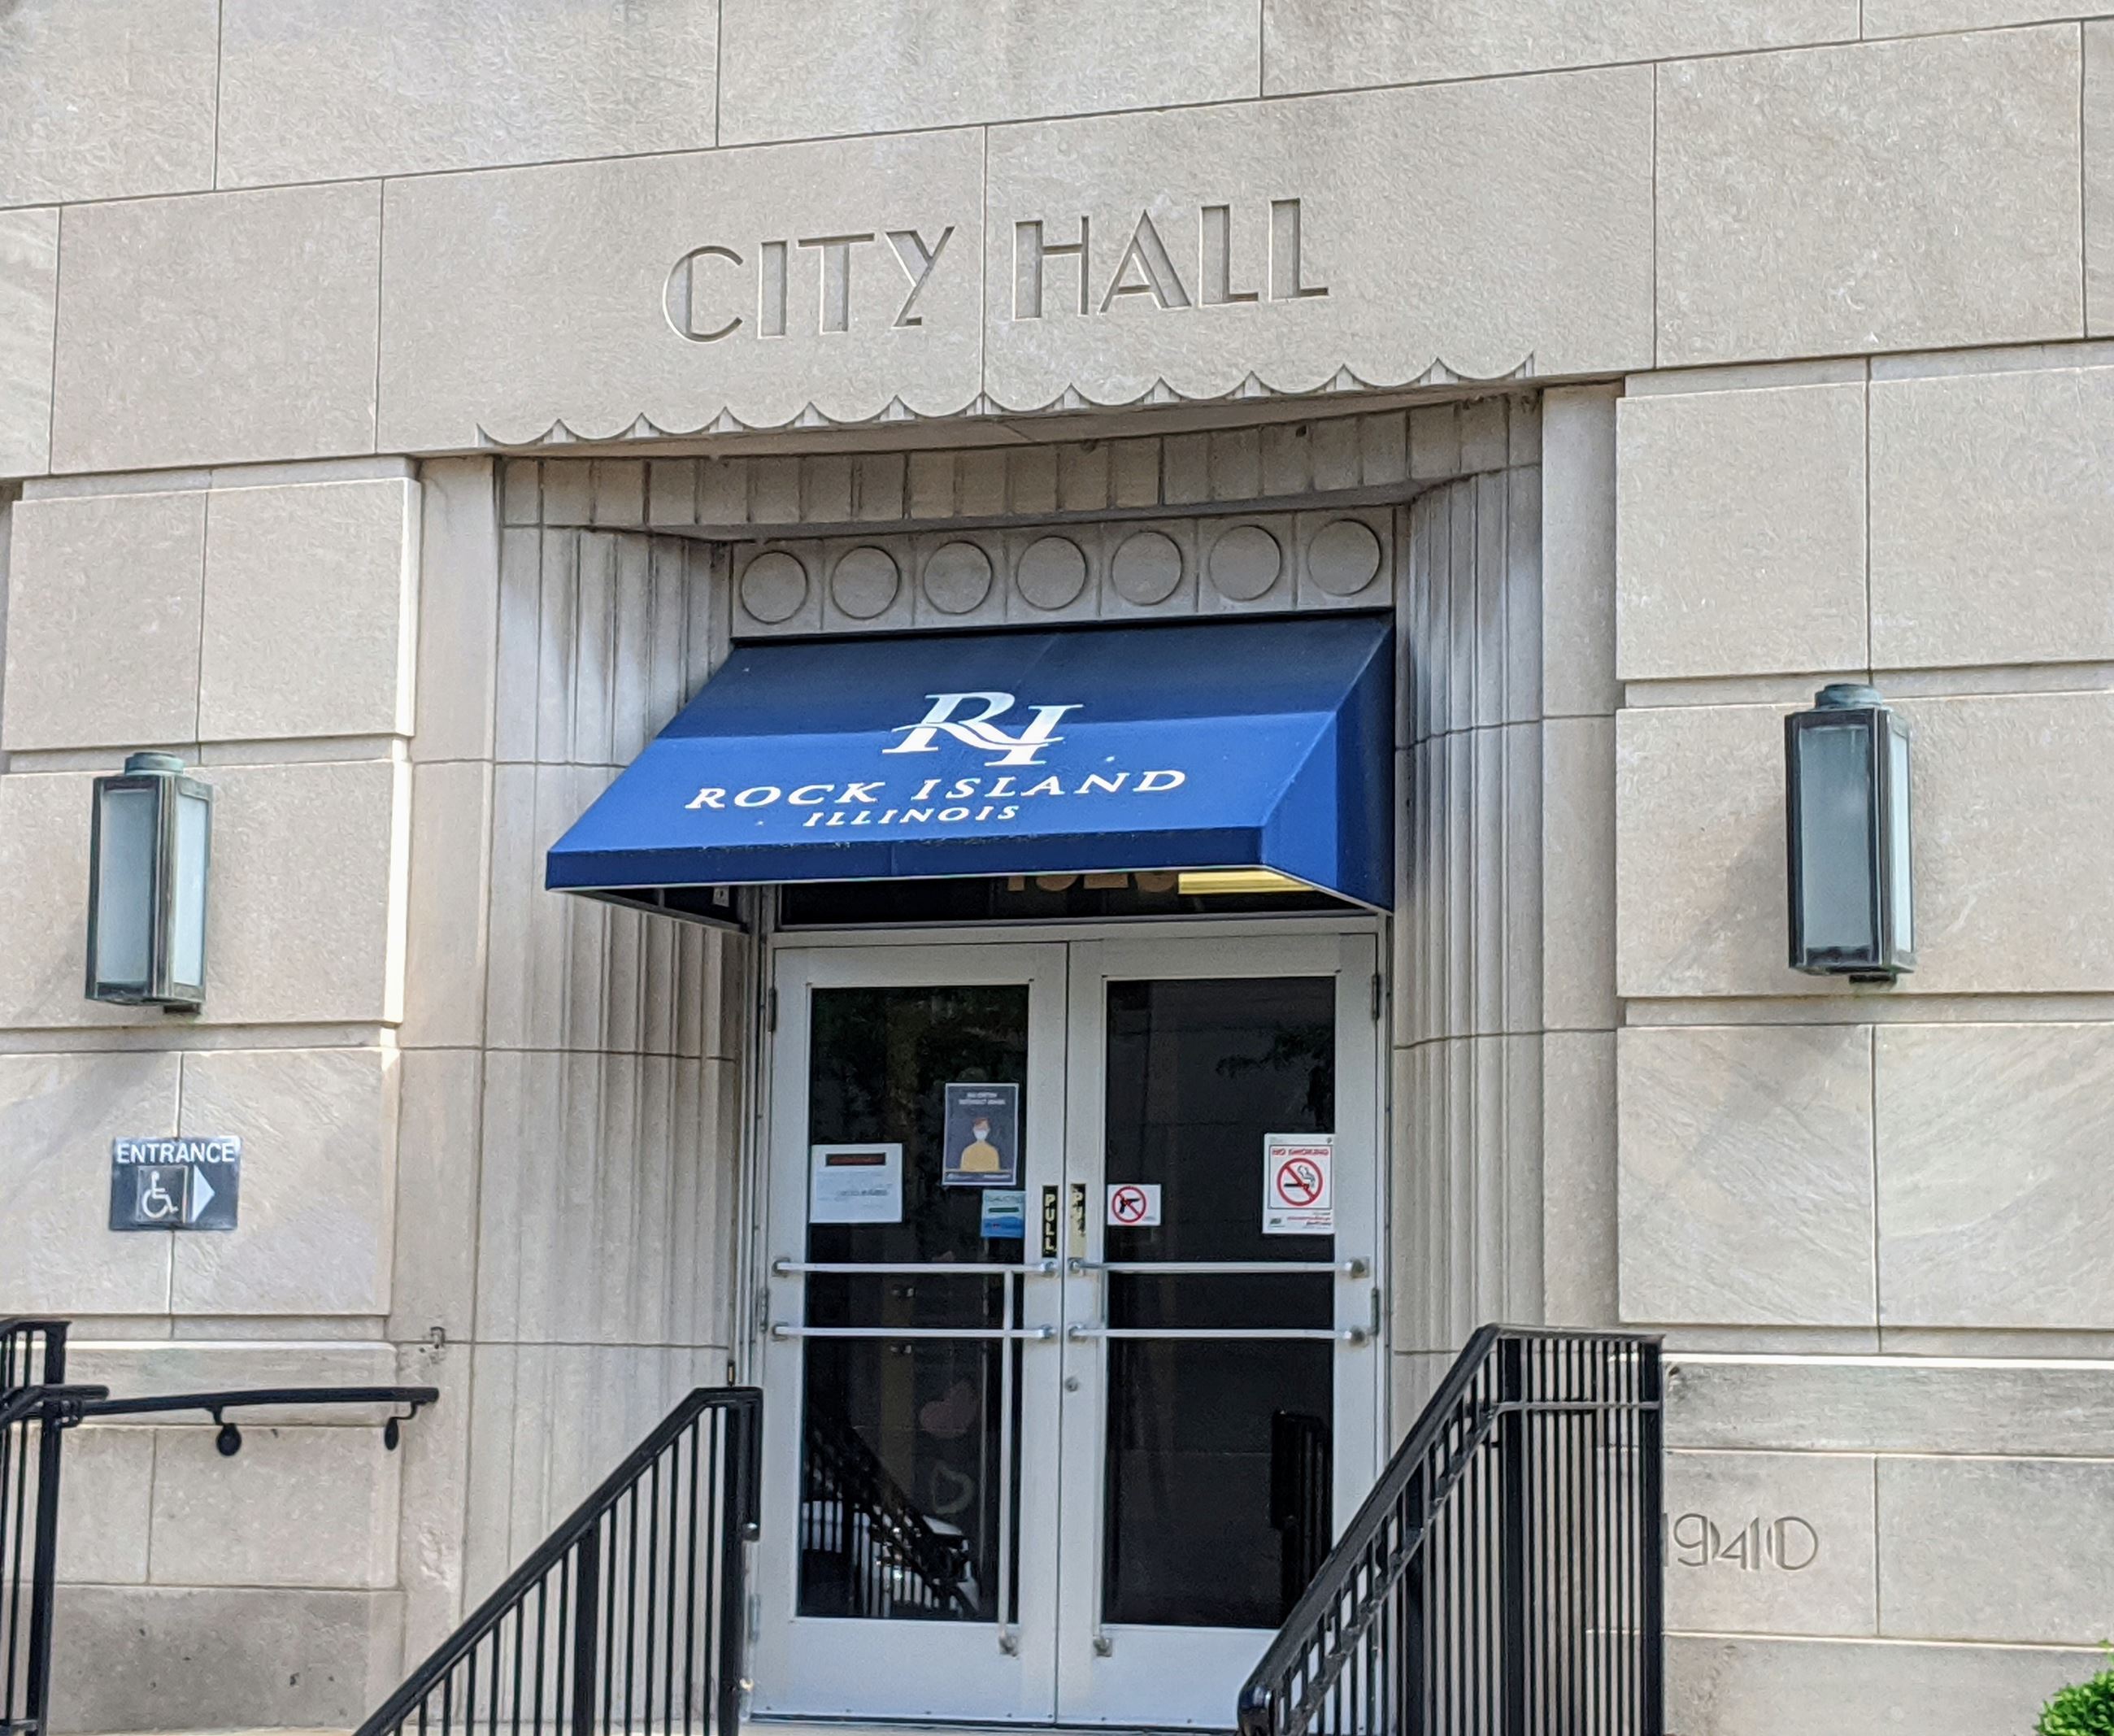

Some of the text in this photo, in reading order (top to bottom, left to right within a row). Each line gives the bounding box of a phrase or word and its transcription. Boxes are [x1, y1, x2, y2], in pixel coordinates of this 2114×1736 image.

[662, 198, 1329, 343] CITY HALL
[882, 692, 1083, 766] RI
[685, 771, 1186, 809] ROCK ISLAND
[803, 805, 1019, 827] ILLINOIS
[116, 1142, 236, 1164] ENTRANCE
[1044, 1193, 1056, 1251] PULL
